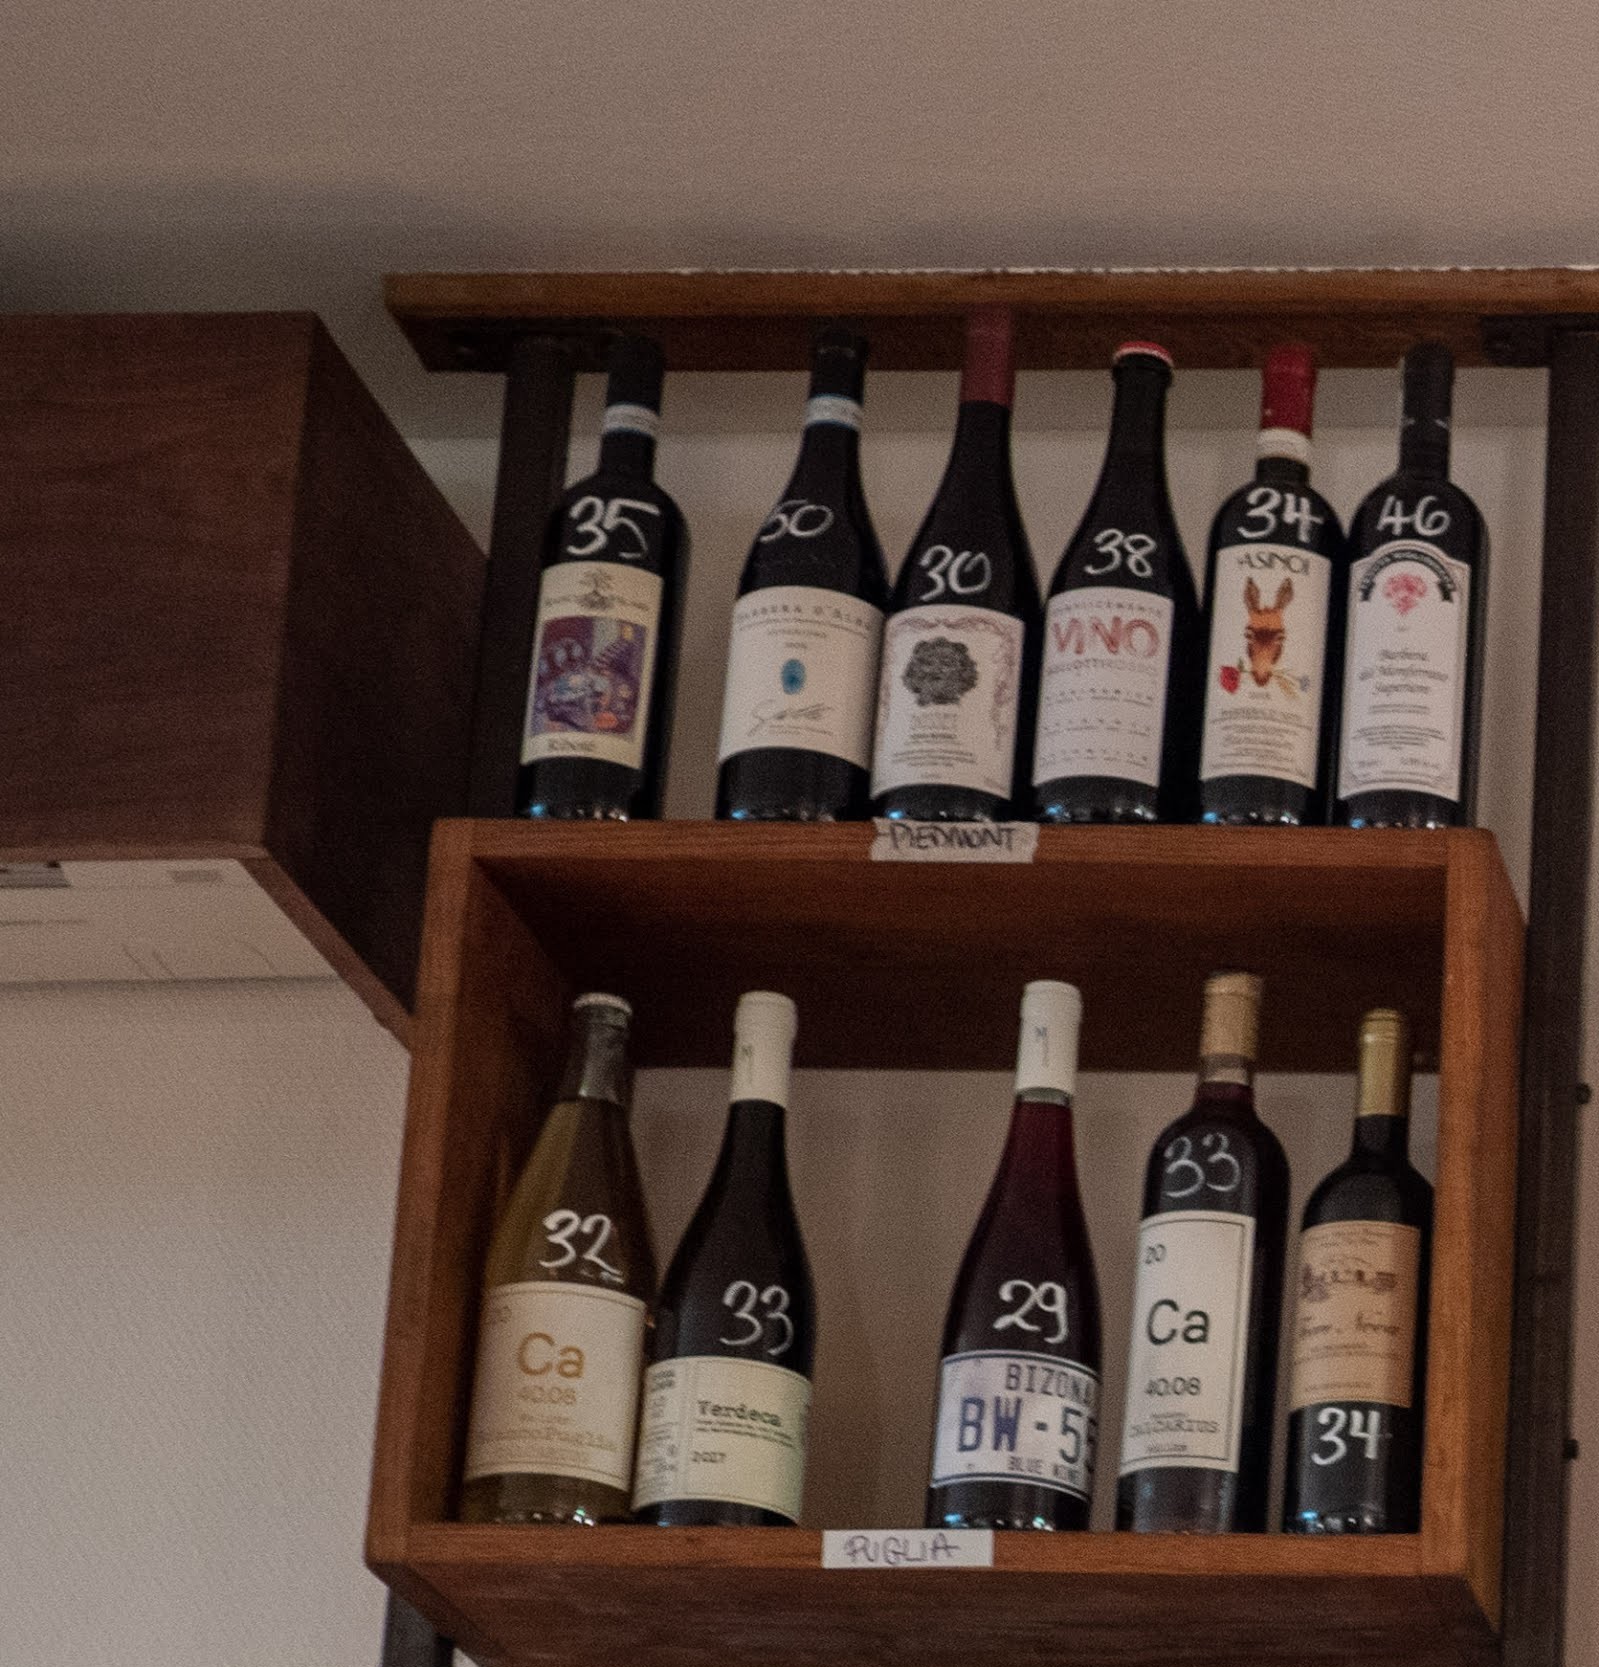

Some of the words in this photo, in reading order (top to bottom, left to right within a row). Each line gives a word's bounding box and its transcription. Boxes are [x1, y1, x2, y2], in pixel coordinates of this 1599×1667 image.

[567, 496, 660, 558] 35
[1237, 487, 1323, 543] 34
[1377, 496, 1450, 536] 46
[919, 545, 991, 601] 30
[1085, 529, 1156, 578] 38
[1164, 1133, 1242, 1197] 33
[539, 1209, 626, 1285] 32
[720, 1281, 794, 1356] 33
[993, 1280, 1069, 1344] 29
[1147, 1299, 1210, 1345] Ca
[517, 1331, 585, 1379] Ca
[1311, 1406, 1394, 1466] 34
[843, 1533, 961, 1566] PUGLIA
